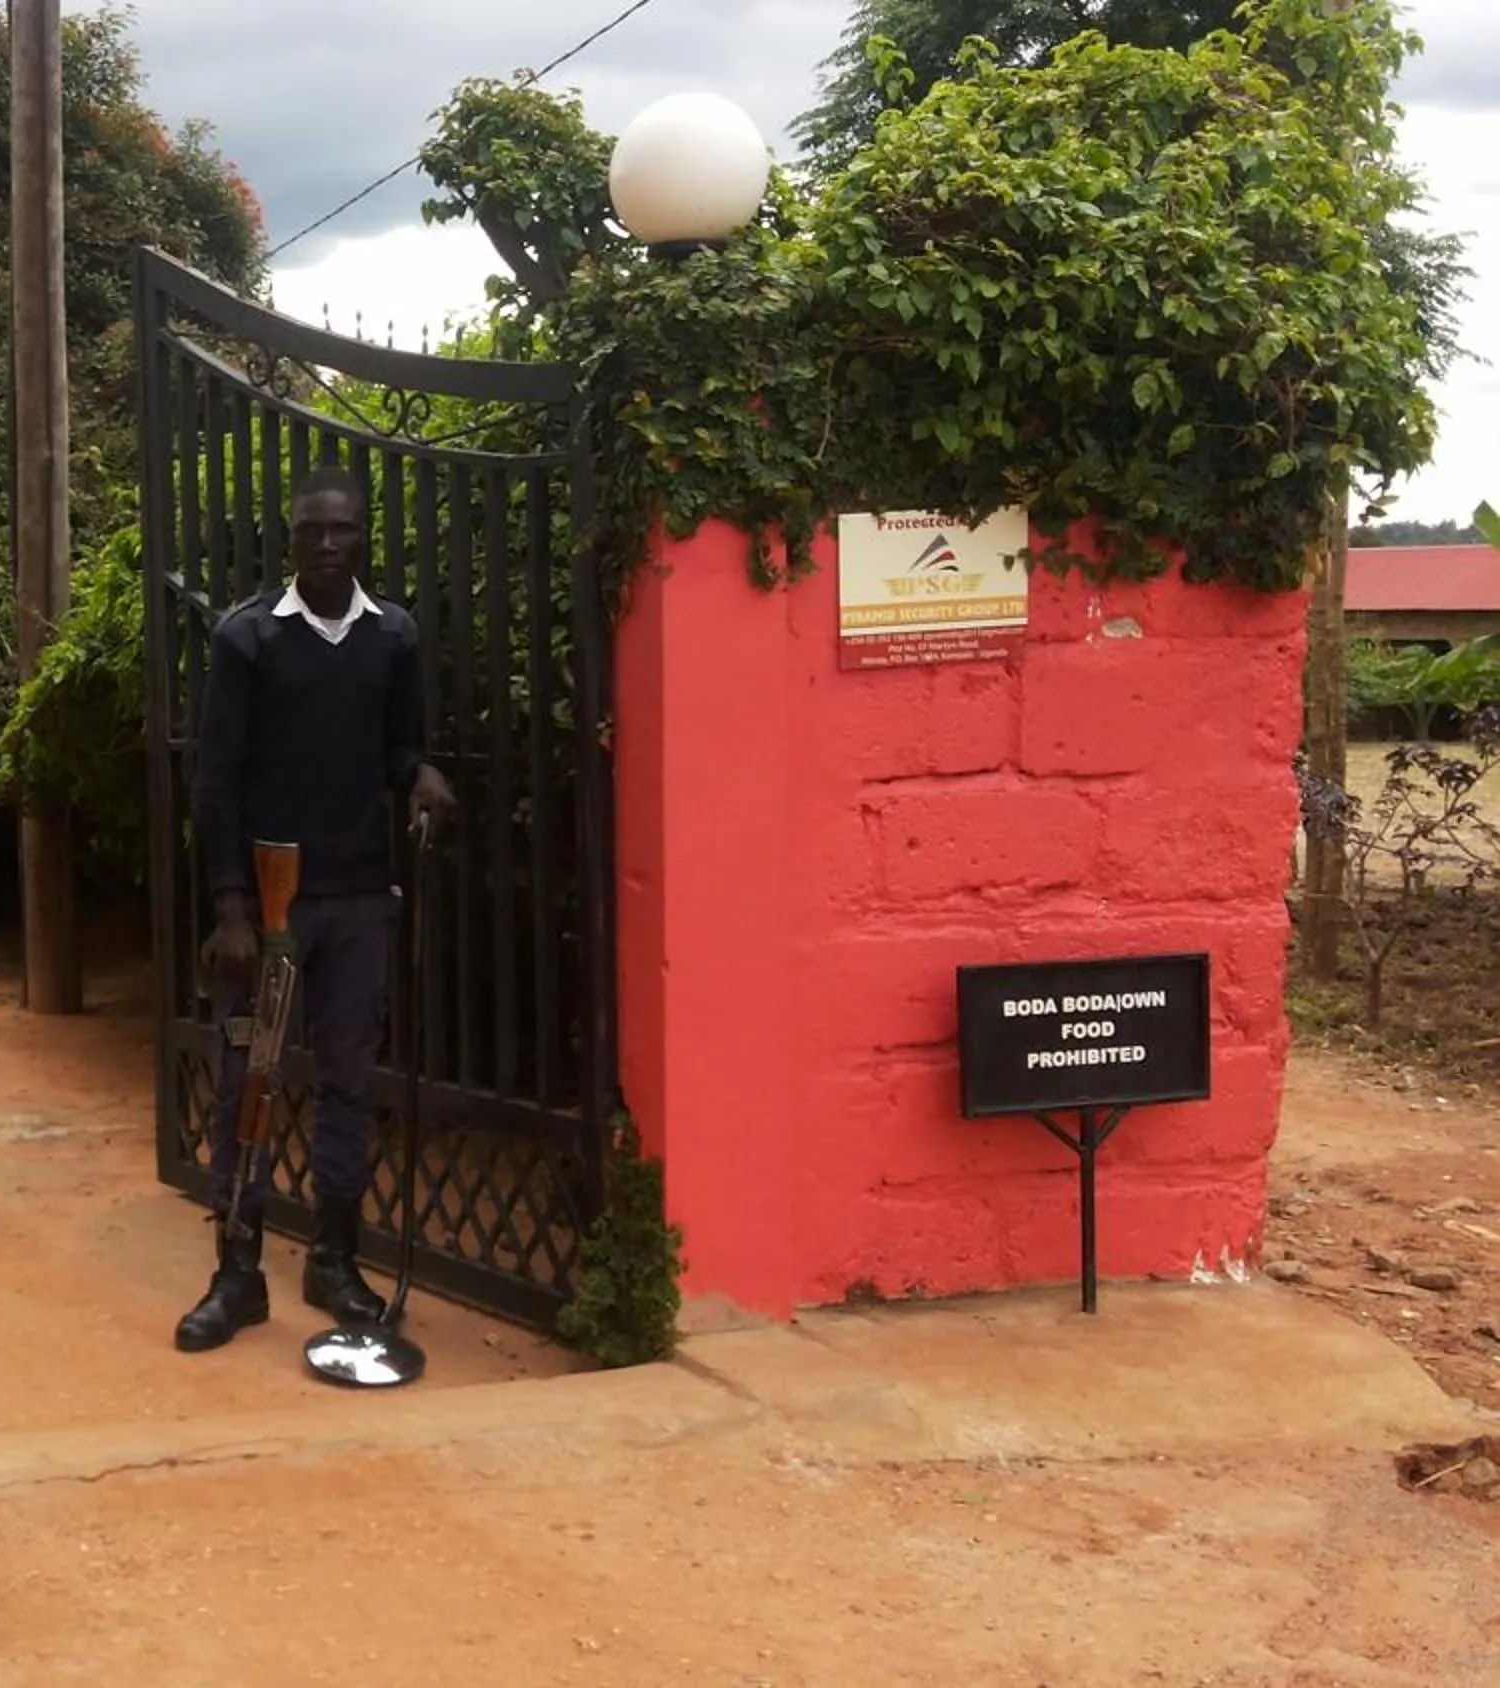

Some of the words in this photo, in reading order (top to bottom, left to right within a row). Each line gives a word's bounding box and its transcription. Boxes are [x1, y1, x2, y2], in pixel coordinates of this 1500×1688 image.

[877, 516, 955, 531] Protected
[899, 604, 954, 622] SECURITY
[957, 602, 1000, 617] GROUP
[1002, 600, 1025, 614] LTD
[1003, 998, 1058, 1017] BODA
[1061, 1021, 1116, 1040] FOOD
[1027, 1045, 1147, 1069] PROHIBITED
